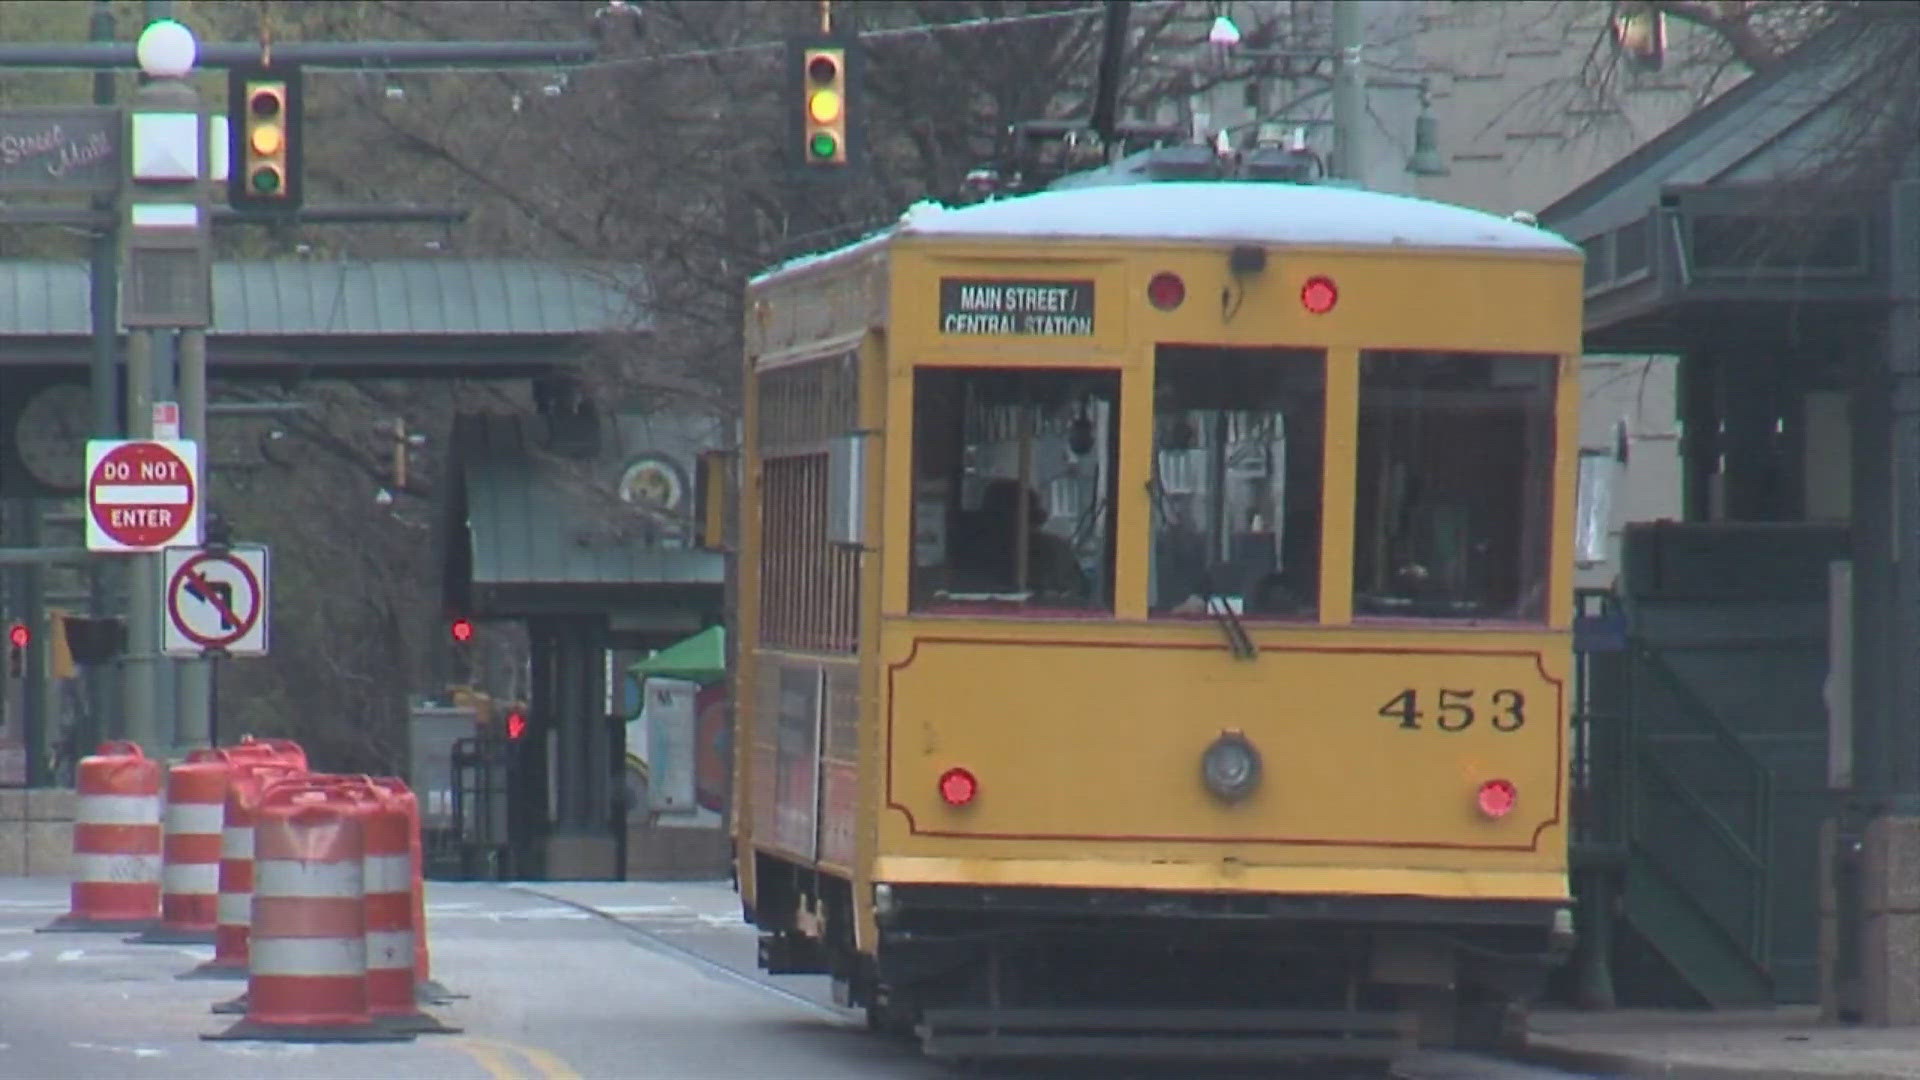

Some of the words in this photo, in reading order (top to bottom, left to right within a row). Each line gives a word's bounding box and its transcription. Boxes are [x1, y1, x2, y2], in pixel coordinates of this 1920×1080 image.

[1, 124, 64, 164] Street
[47, 131, 112, 176] Mall
[961, 286, 1001, 310] MAIN
[1005, 287, 1068, 312] STREET
[945, 313, 1016, 334] CENTRAL
[1024, 315, 1092, 337] STATION
[104, 461, 130, 480] DO
[140, 461, 179, 480] NOT
[110, 508, 172, 528] ENTER
[1377, 687, 1526, 733] 453
